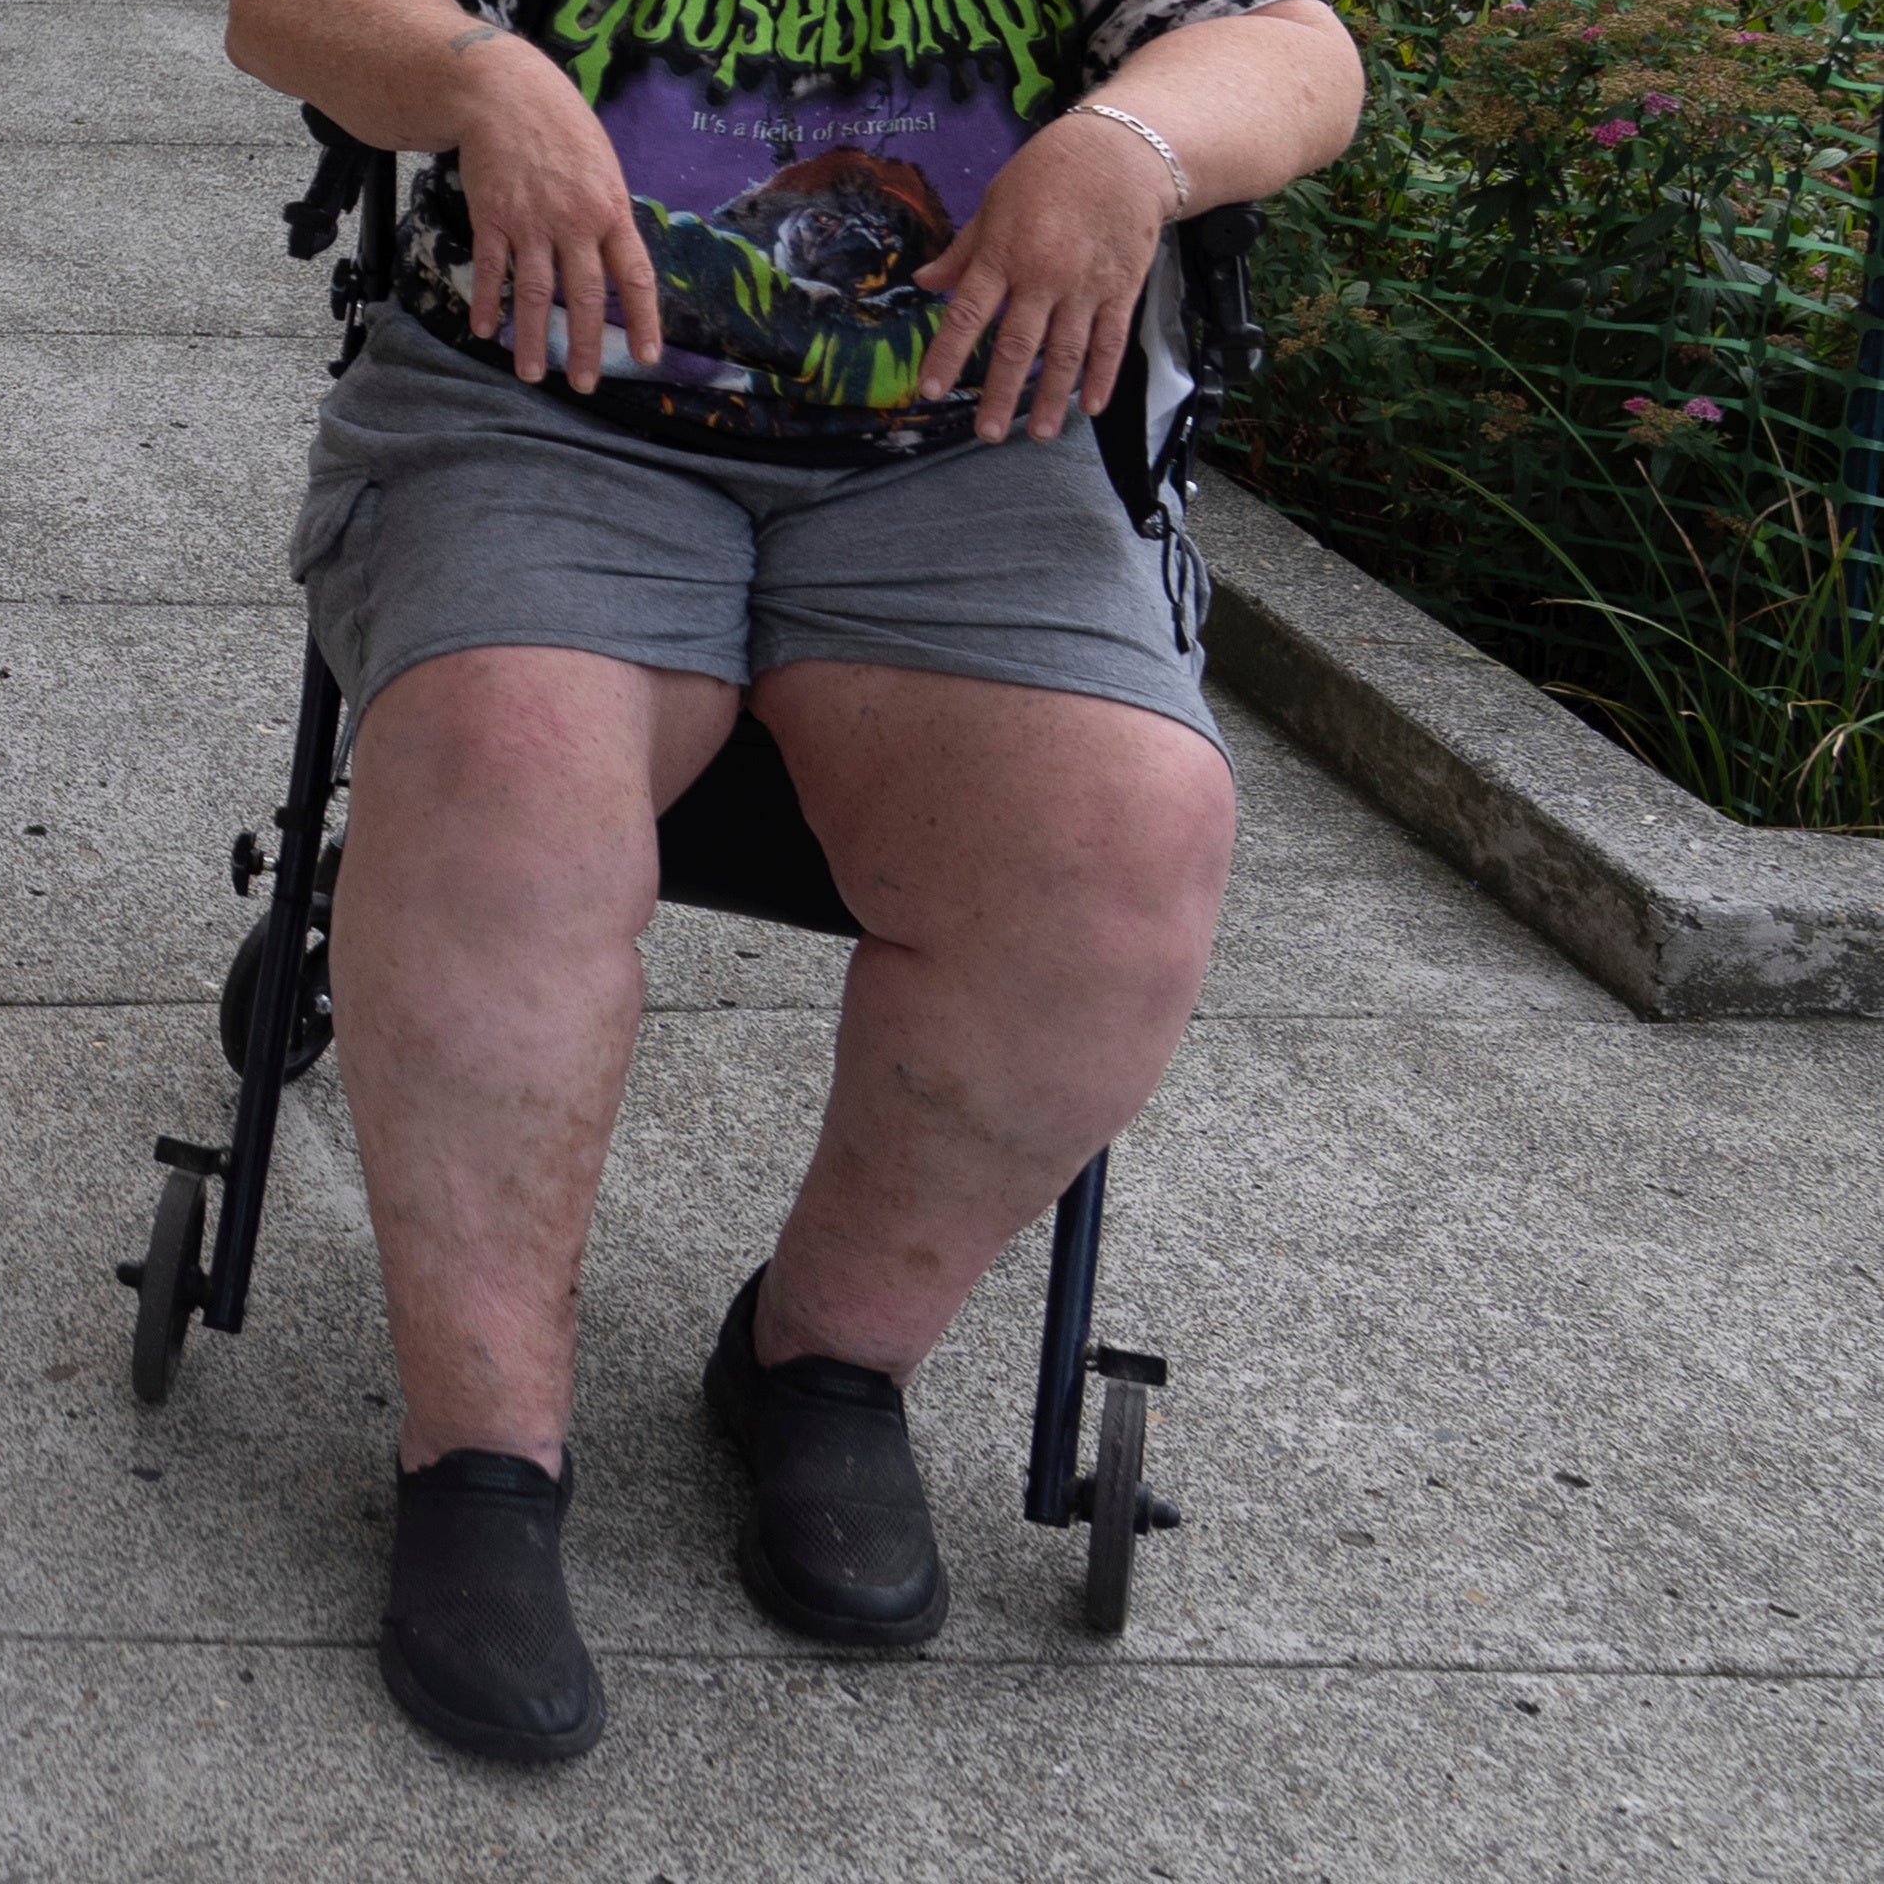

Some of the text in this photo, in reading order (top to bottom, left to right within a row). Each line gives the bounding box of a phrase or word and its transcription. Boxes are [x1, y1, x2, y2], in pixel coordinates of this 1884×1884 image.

[691, 111, 937, 143] It's a field of screams!
